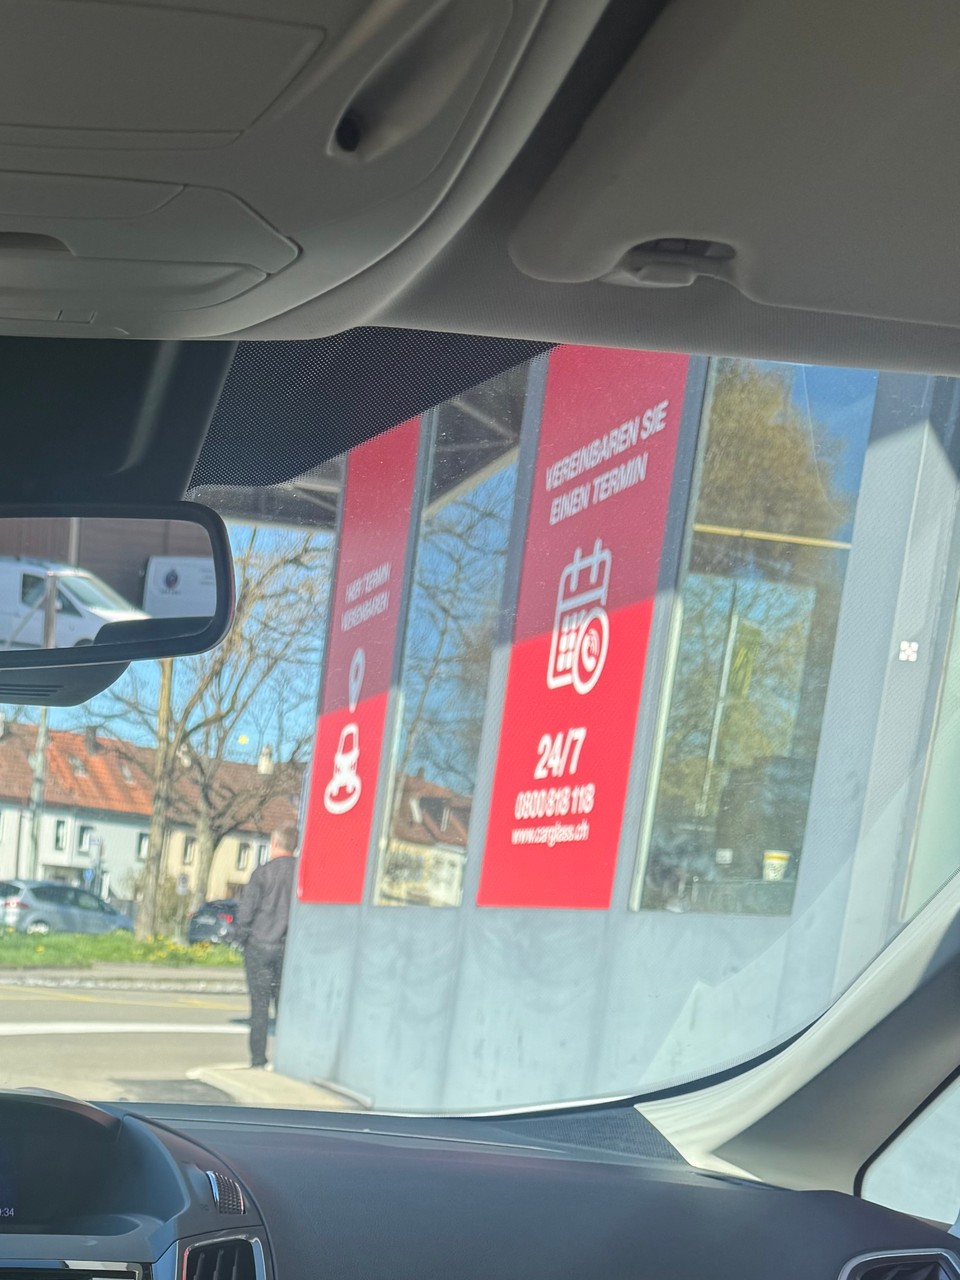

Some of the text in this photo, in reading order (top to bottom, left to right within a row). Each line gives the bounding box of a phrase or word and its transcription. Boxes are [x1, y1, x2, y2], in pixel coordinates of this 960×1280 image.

[546, 399, 669, 491] VEREINBAREN SIE
[549, 450, 648, 525] EINEN TERMIN
[533, 726, 587, 780] 24/7
[514, 788, 547, 820] 0800
[511, 818, 590, 848] www.carglass.ch
